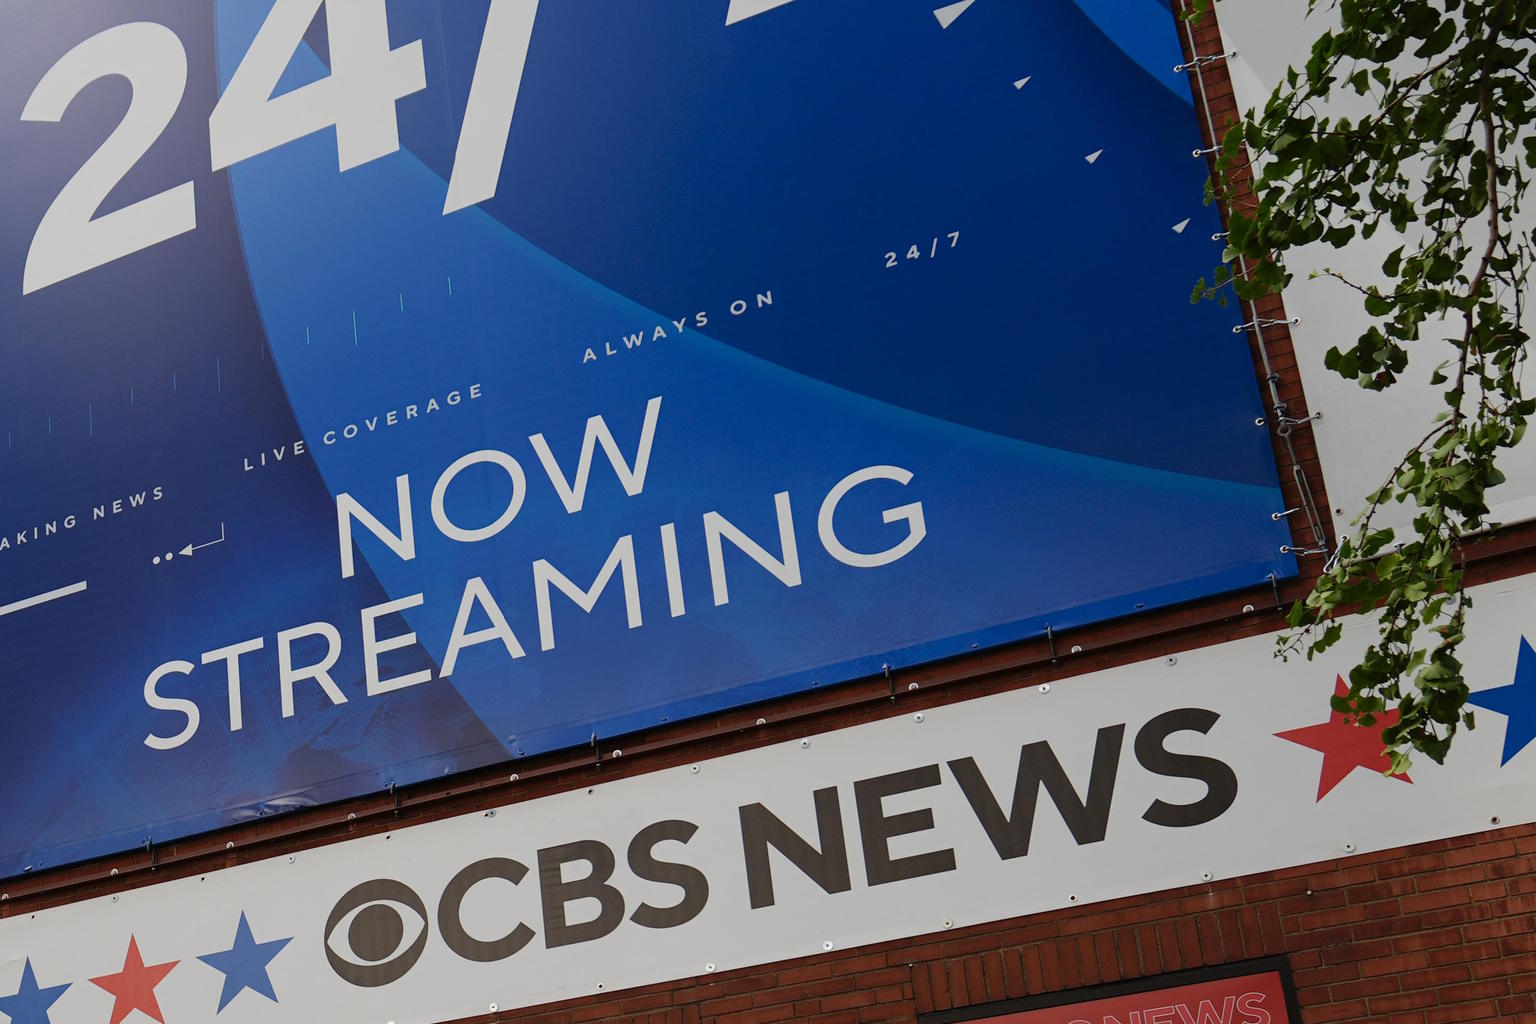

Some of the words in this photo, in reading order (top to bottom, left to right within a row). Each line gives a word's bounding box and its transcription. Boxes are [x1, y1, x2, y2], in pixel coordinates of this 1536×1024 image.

[884, 231, 960, 268] 24/7
[582, 312, 708, 363] ALWAYS
[729, 291, 773, 315] ON
[244, 440, 305, 472] LIVE
[322, 383, 483, 446] COVERAGE
[93, 486, 165, 520] NEWS
[336, 396, 662, 579] NOW
[143, 464, 927, 749] STREAMING
[436, 818, 710, 963] CBS
[740, 707, 1239, 910] NEWS
